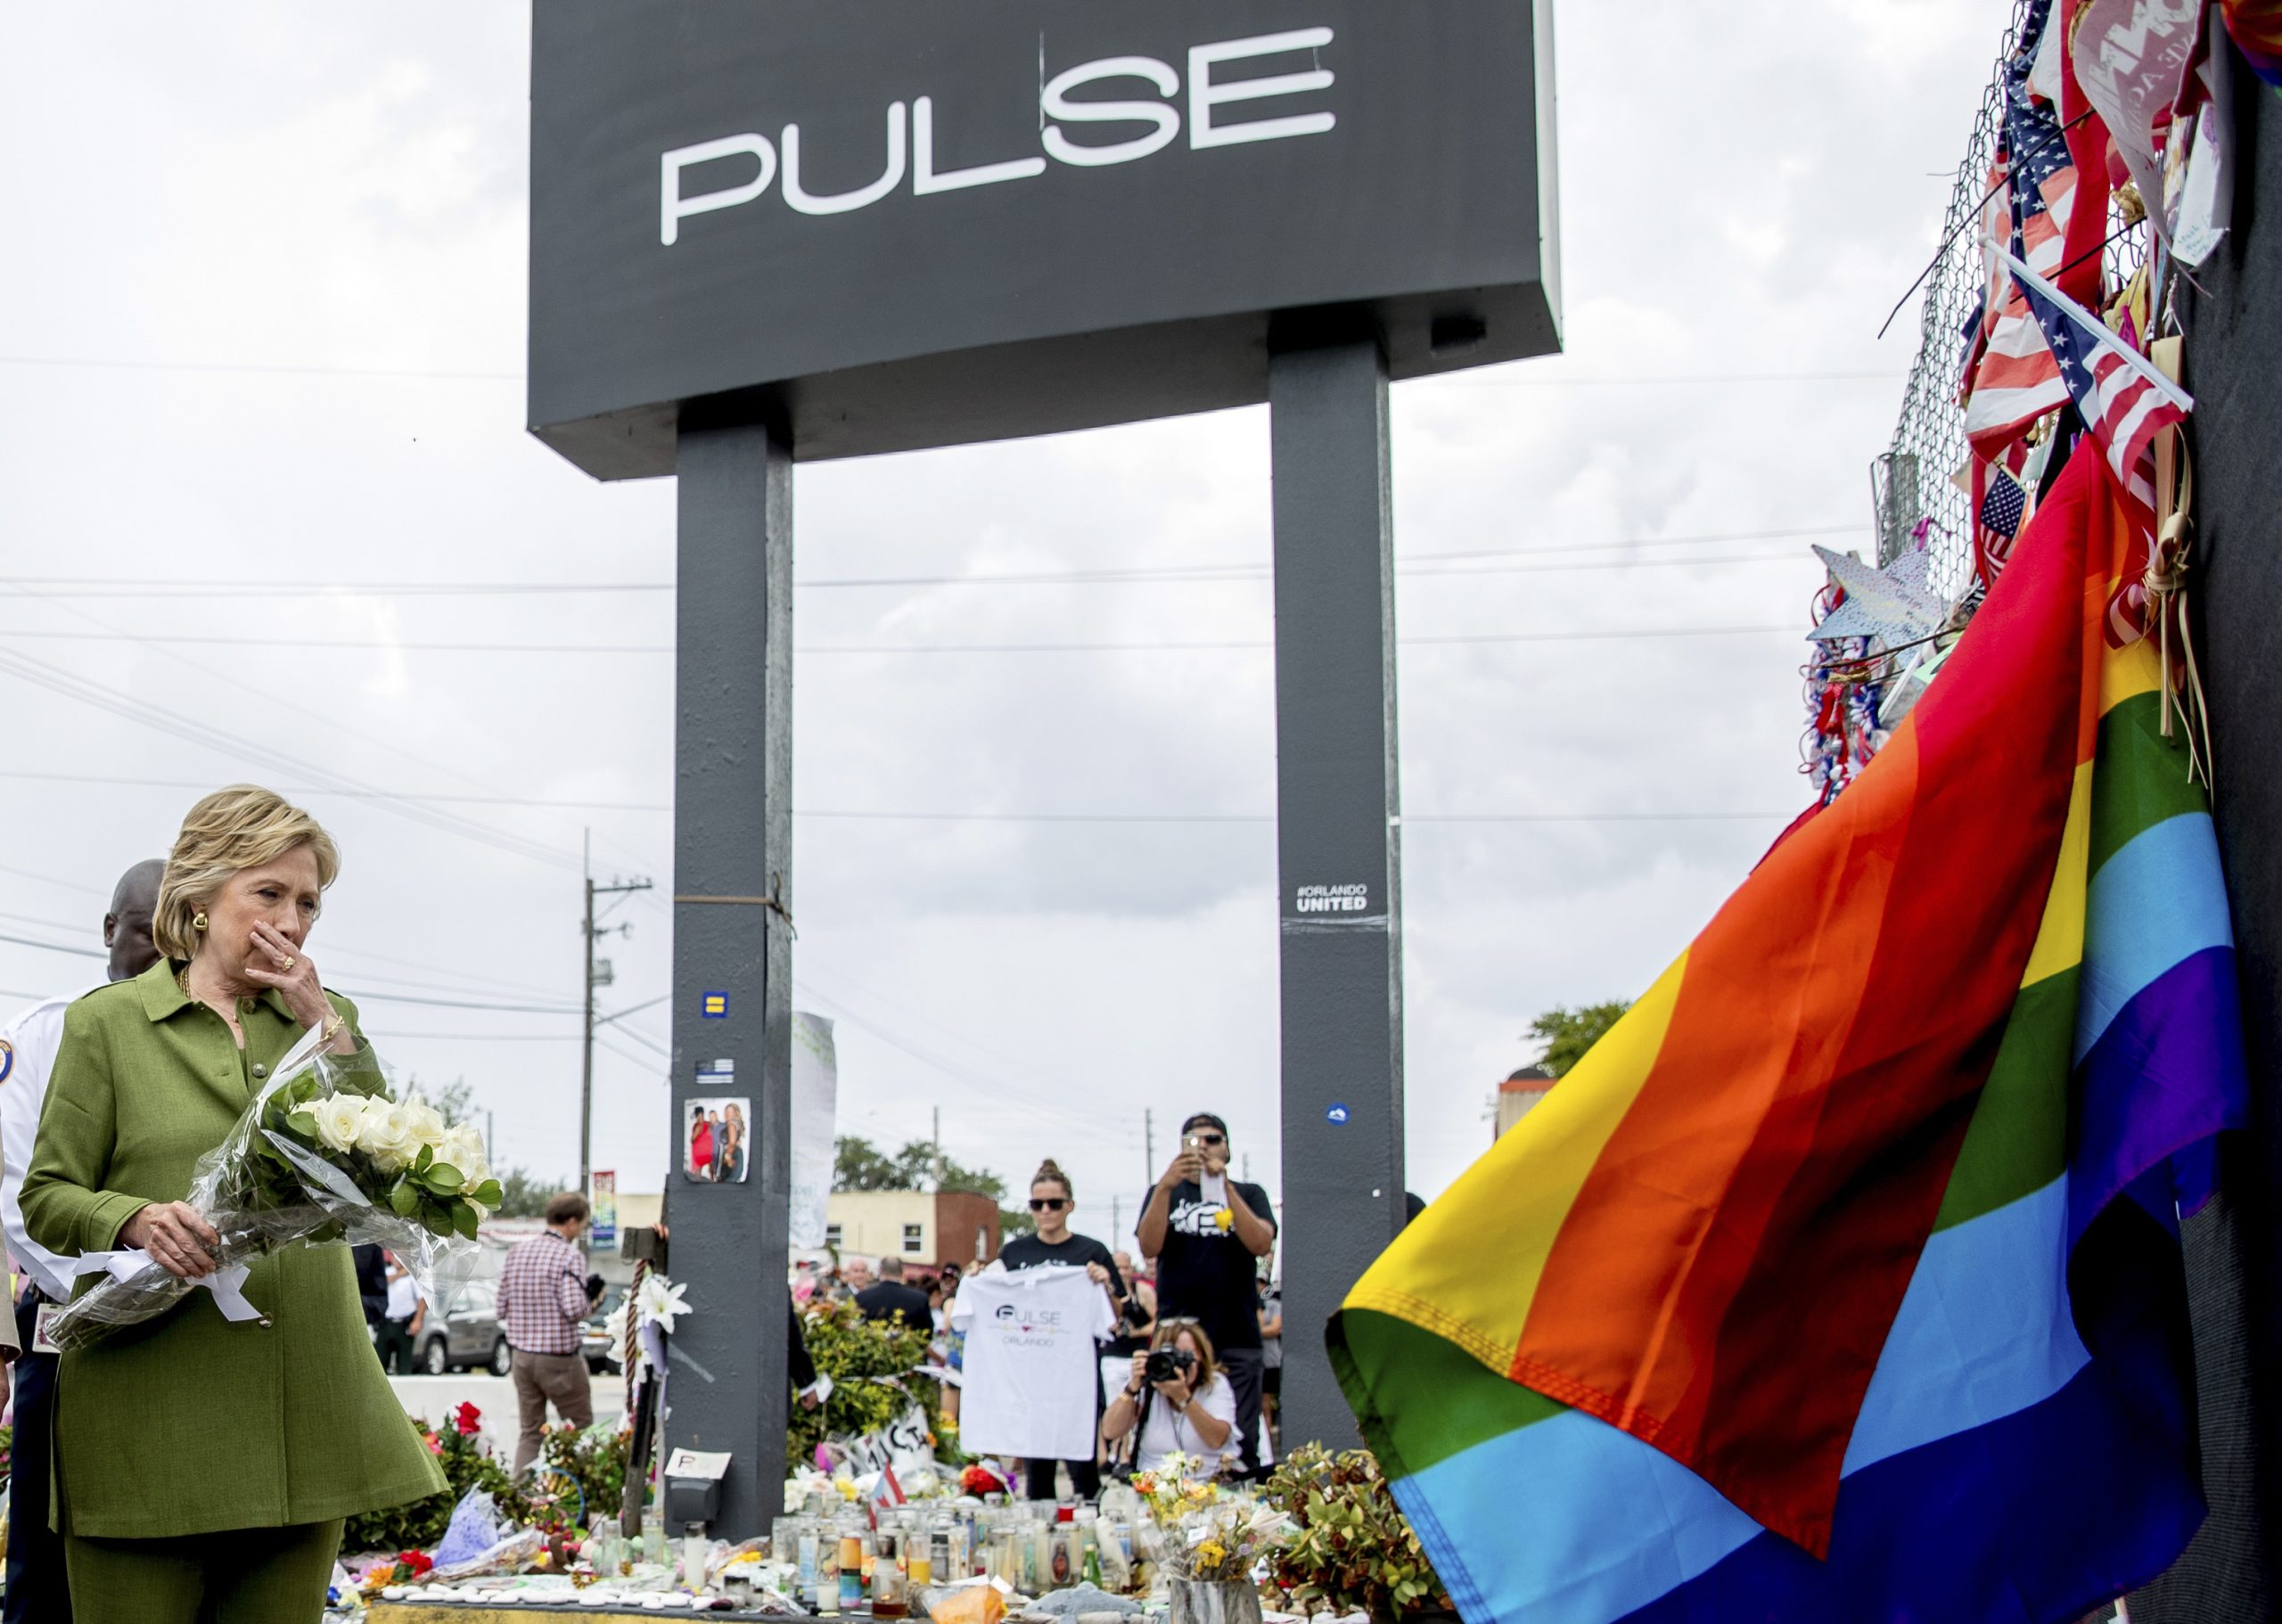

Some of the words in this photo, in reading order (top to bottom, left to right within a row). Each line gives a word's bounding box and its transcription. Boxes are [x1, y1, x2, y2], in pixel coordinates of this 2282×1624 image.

[661, 27, 1336, 247] PULSE
[1297, 883, 1368, 898] #ORLANDO
[1296, 895, 1367, 913] UNITED
[1001, 1336, 1055, 1348] ORLANDO
